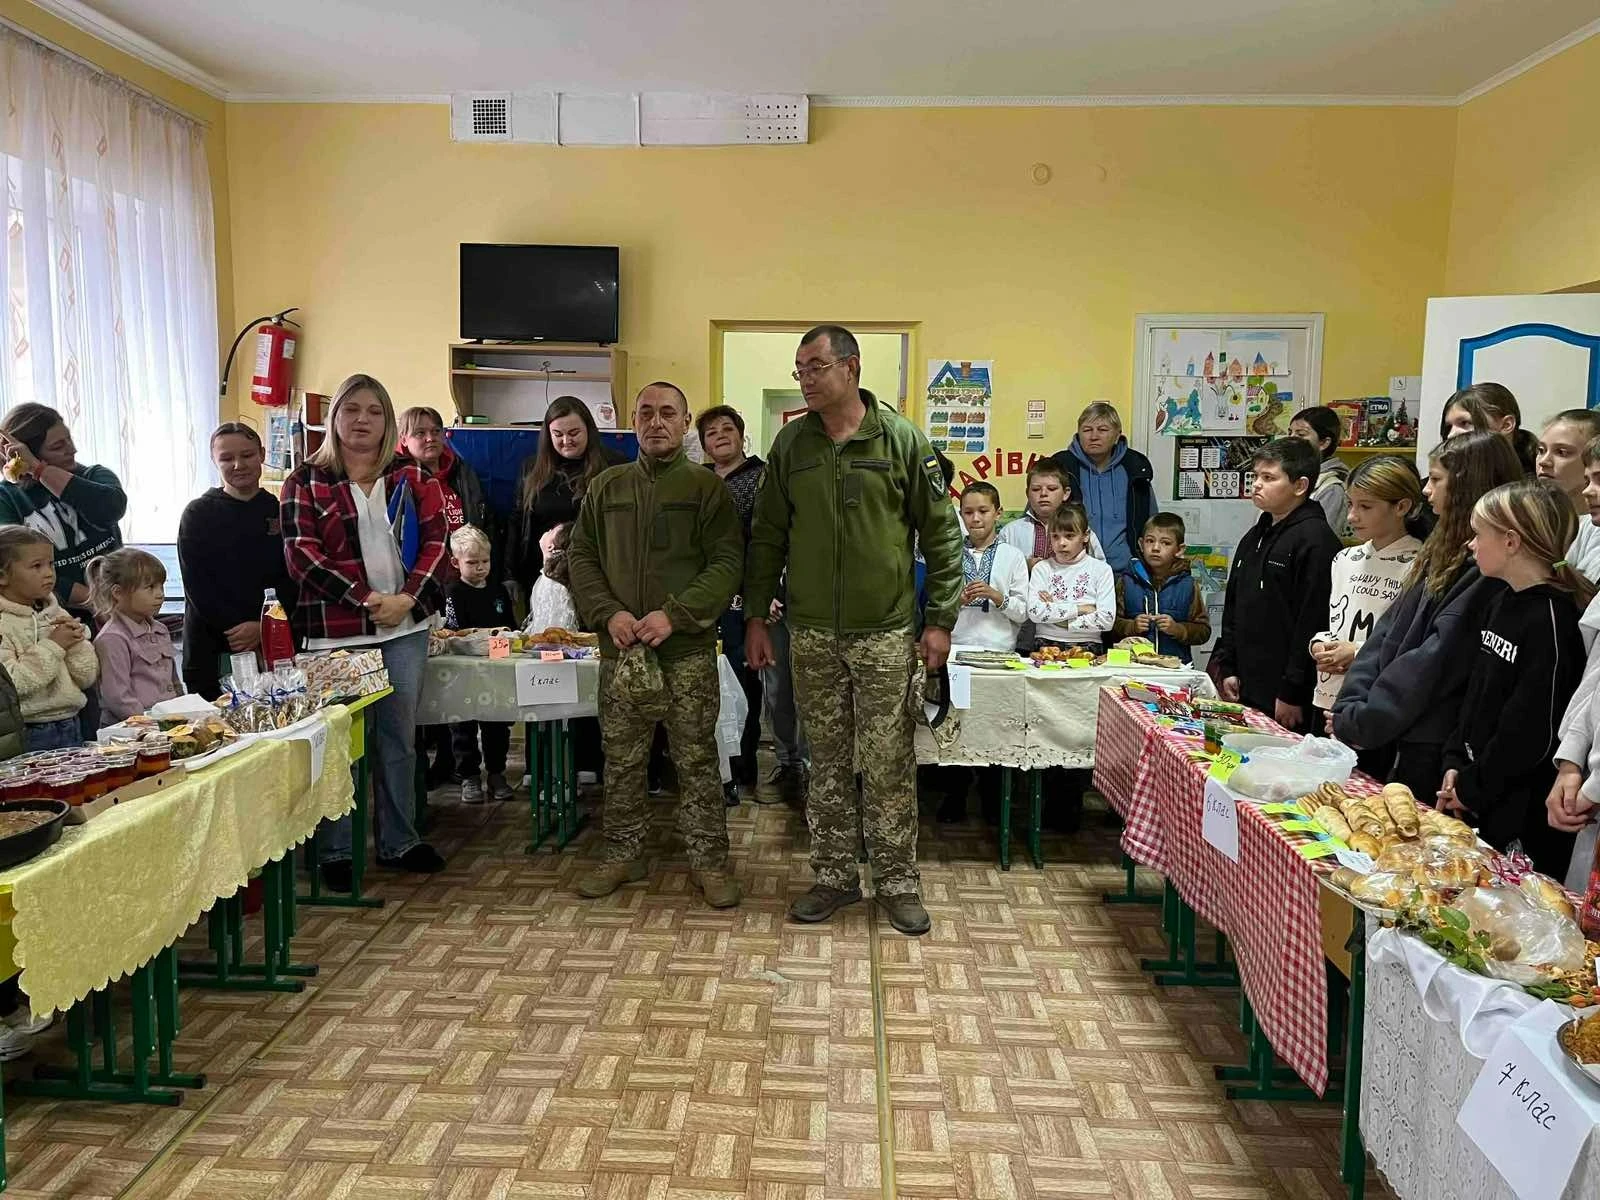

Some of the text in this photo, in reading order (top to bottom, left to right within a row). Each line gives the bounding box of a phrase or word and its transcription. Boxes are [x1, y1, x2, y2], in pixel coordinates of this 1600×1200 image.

[1356, 586, 1379, 597] COULD
[1380, 590, 1399, 601] SAY
[1498, 1063, 1556, 1130] 7 клас
